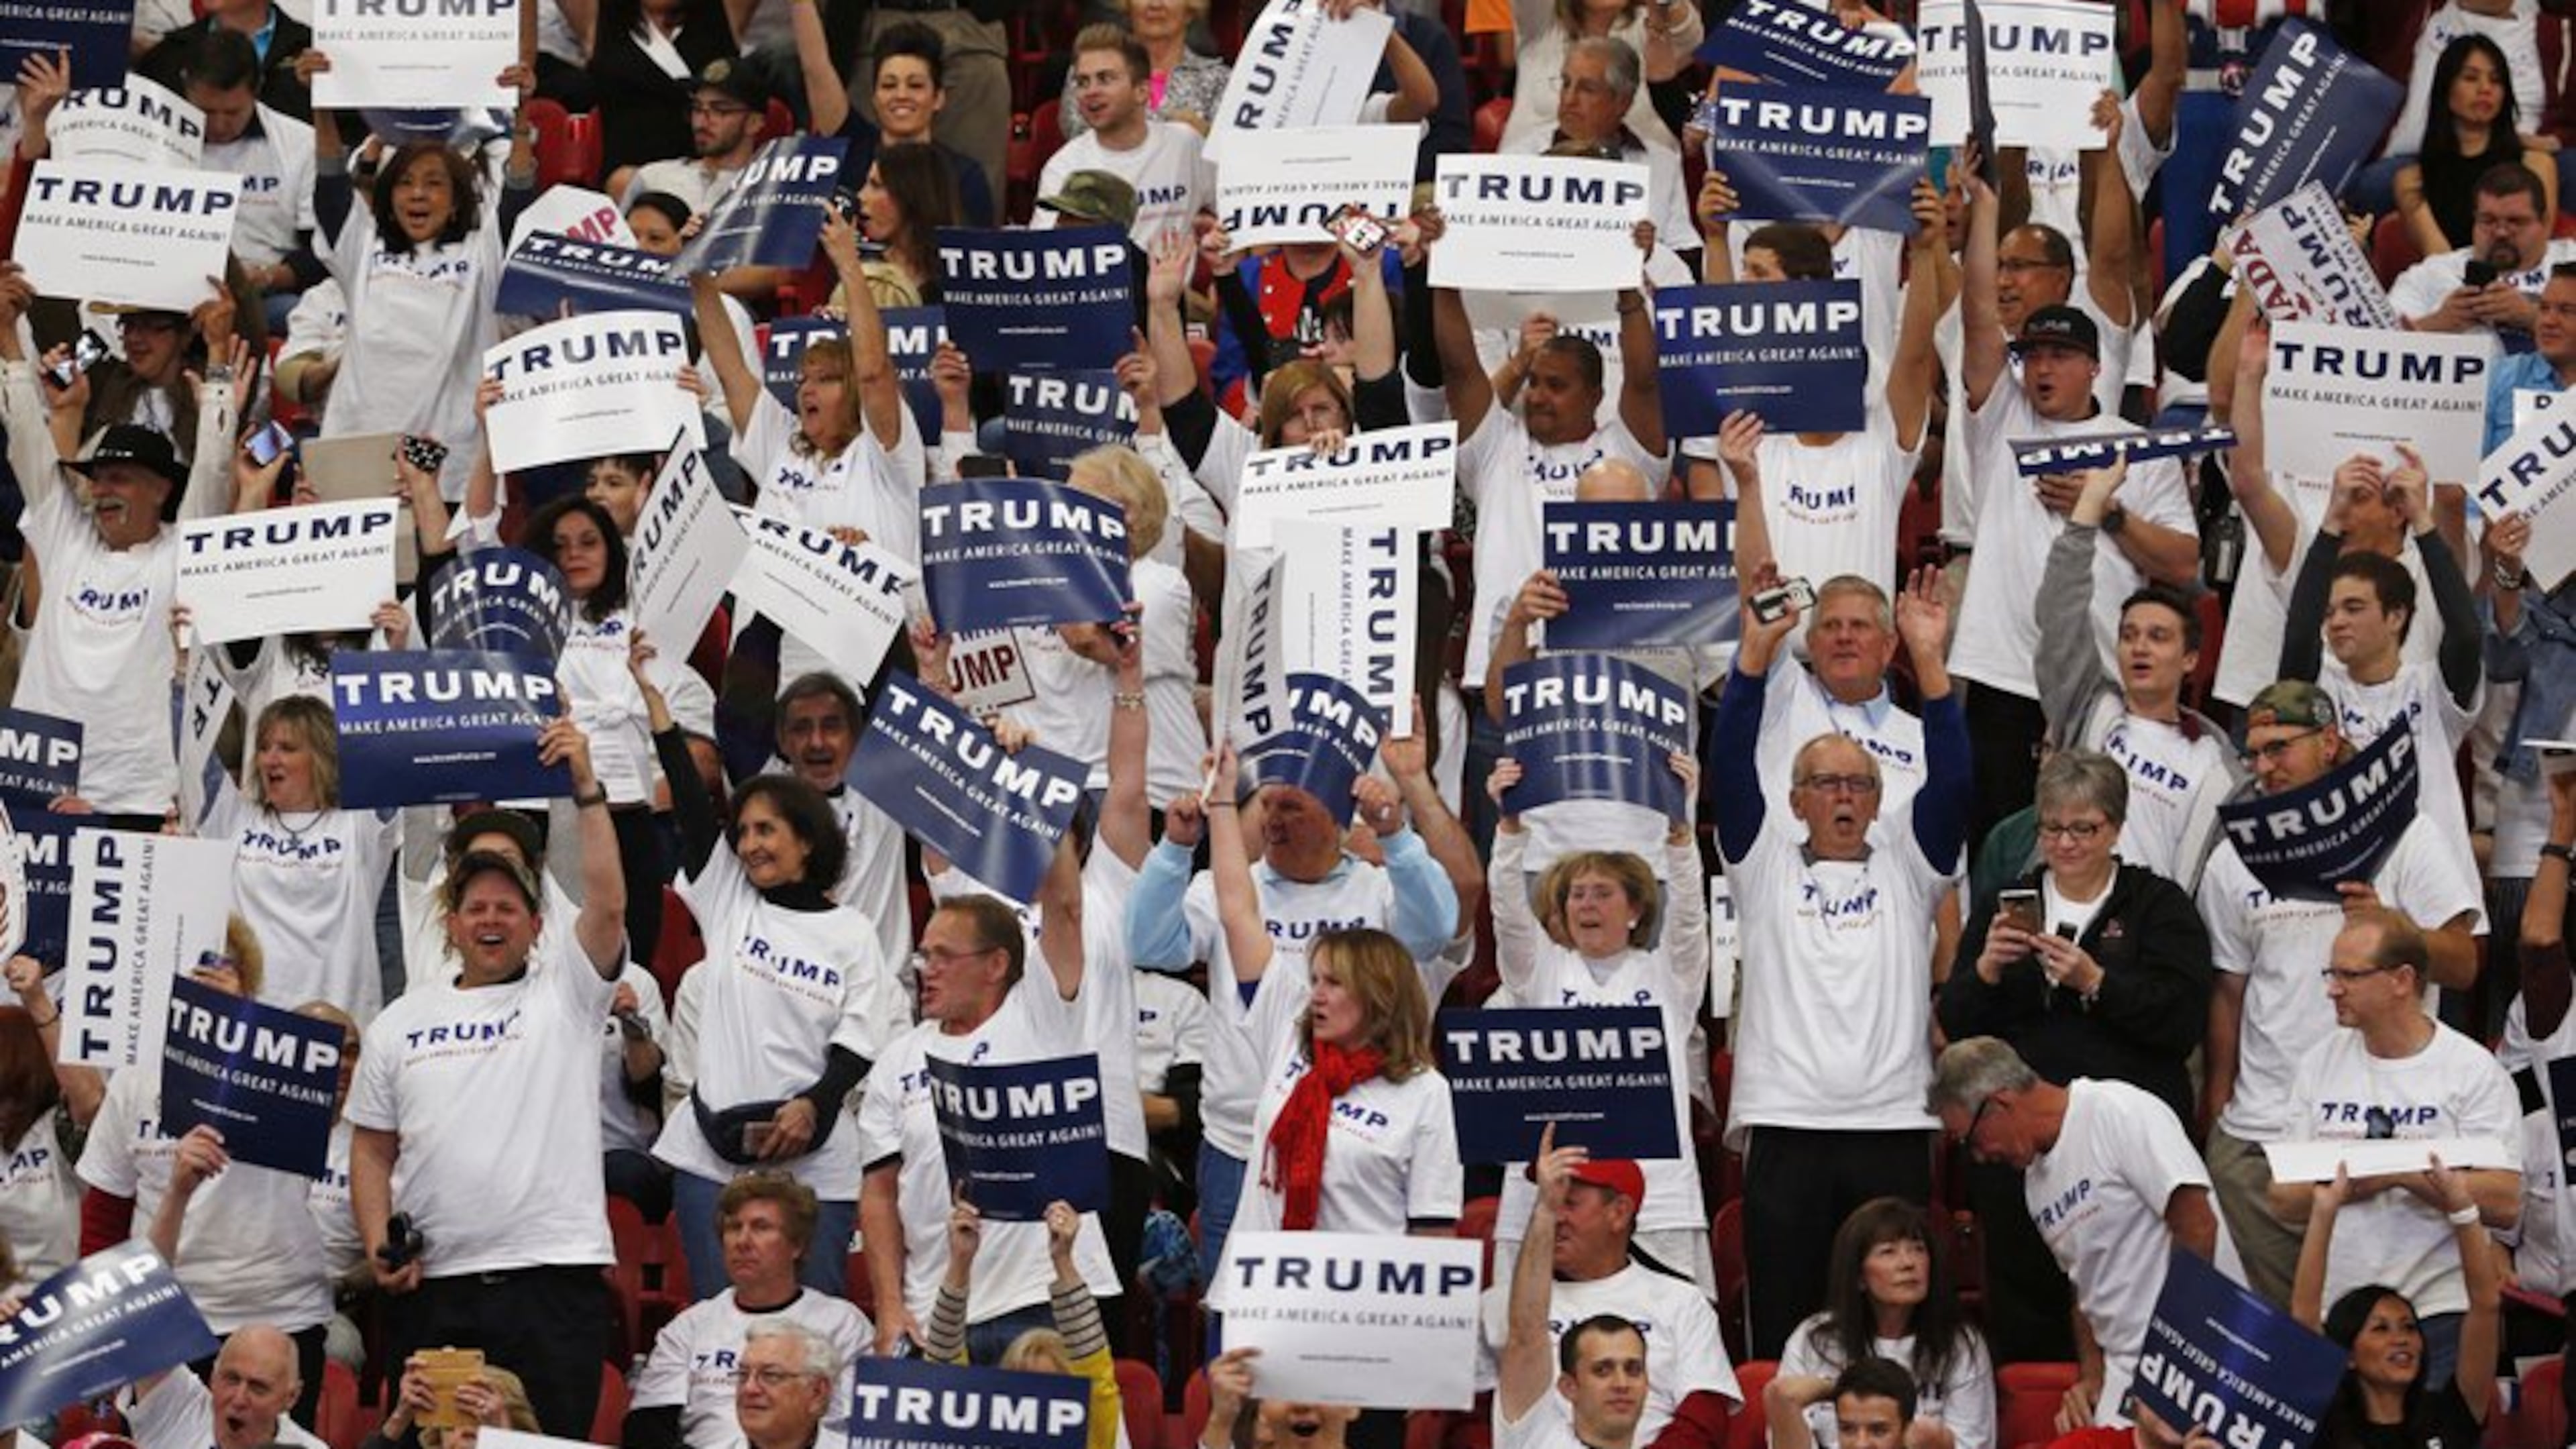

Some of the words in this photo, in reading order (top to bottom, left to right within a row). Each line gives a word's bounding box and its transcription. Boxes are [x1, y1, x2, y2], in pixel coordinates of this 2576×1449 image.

[0, 7, 41, 23] ERICA
[44, 8, 85, 21] GREAT
[325, 0, 516, 17] TRUMP
[317, 30, 352, 41] MAKE
[358, 30, 419, 41] AMERICA
[423, 30, 464, 41] GREAT
[1746, 0, 1916, 62] TRUMP
[1760, 28, 1815, 55] AMERICA
[1817, 50, 1853, 69] GREAT
[2013, 67, 2057, 80] GREAT
[1719, 97, 1928, 140] TRUMP
[2209, 32, 2320, 216] TRUMP
[1717, 138, 1755, 152] MAKE
[1759, 140, 1823, 158] AMERICA
[1828, 147, 1869, 162] GREAT
[1875, 152, 1925, 166] AGAIN!
[2254, 140, 2293, 197] AMERICA
[2291, 99, 2320, 142] GREAT
[36, 178, 234, 214] TRUMP
[1442, 174, 1643, 205] TRUMP
[26, 214, 66, 227] MAKE
[71, 216, 127, 233] AMERICA
[132, 222, 174, 237] GREAT
[180, 227, 227, 242] AGAIN!
[1479, 215, 1541, 229] AMERICA
[1546, 218, 1589, 231] GREAT
[941, 247, 1125, 281] TRUMP
[943, 289, 972, 303] MAKE
[975, 291, 1030, 305] AMERICA
[1034, 290, 1075, 305] GREAT
[1079, 287, 1129, 303] AGAIN!
[1657, 302, 1858, 337] TRUMP
[490, 330, 682, 380] TRUMP
[1660, 352, 1692, 368] MAKE
[1696, 349, 1756, 366] AMERICA
[1760, 347, 1804, 362] GREAT
[1809, 345, 1860, 360] AGAIN!
[2274, 341, 2483, 384] TRUMP
[598, 370, 641, 386] GREAT
[1008, 375, 1140, 415] TRUM
[2271, 387, 2310, 402] MAKE
[2314, 391, 2376, 408] AMERICA
[2381, 395, 2426, 411] GREAT
[2430, 398, 2481, 413] AGAIN!
[1042, 420, 1092, 439] AMERICA
[1247, 437, 1450, 476] TRUMP
[1243, 484, 1281, 496] MAKE
[1287, 478, 1350, 492] AMERICA
[1354, 474, 1398, 487] GREAT
[1403, 470, 1452, 484] AGAIN!
[184, 513, 392, 553] TRUMP
[922, 499, 1127, 539] TRUMP
[180, 562, 218, 576] MAKE
[223, 556, 287, 573] AMERICA
[291, 551, 335, 567] GREAT
[341, 544, 390, 560] AGAIN!
[755, 539, 811, 572] AMERICA
[815, 567, 856, 599] GREAT
[924, 549, 961, 564] MAKE
[965, 541, 1030, 561] AMERICA
[1034, 540, 1083, 556] GREAT
[433, 561, 564, 614] TRUM
[1593, 566, 1653, 580] AMERICA
[1660, 566, 1703, 580] GREAT
[1369, 527, 1396, 707] TRUM
[1243, 566, 1274, 734] TRUMP
[337, 669, 554, 706] TRUMP
[1505, 675, 1685, 725] TRUMP
[339, 720, 382, 735] MAKE
[386, 715, 455, 733] AMERICA
[460, 712, 504, 728] GREAT
[1543, 718, 1597, 737] AMERICA
[1602, 720, 1645, 739] GREAT
[887, 686, 1077, 807] TRUMP
[872, 716, 909, 745] MAKE
[910, 740, 967, 789] AMERICA
[965, 780, 1010, 817] GREAT
[1010, 811, 1063, 839] AGAIN!
[2228, 740, 2412, 845] TRUMP
[2285, 833, 2349, 863] AMERICA
[142, 841, 155, 896] AGAIN!
[138, 900, 150, 944] GREAT
[82, 837, 126, 1059] TRUMP
[129, 947, 146, 1019] AMERICA
[126, 1022, 137, 1066] MAKE
[168, 998, 340, 1073] TRUMP
[1448, 1028, 1663, 1062] TRUMP
[233, 1071, 276, 1094] GREAT
[280, 1081, 332, 1106] AGAIN!
[1452, 1077, 1494, 1091] MAKE
[1497, 1076, 1563, 1091] AMERICA
[1566, 1075, 1611, 1090] GREAT
[1615, 1073, 1668, 1088] AGAIN!
[1000, 1130, 1046, 1148] GREAT
[1049, 1124, 1103, 1144] AGAIN!
[1236, 1257, 1474, 1297] TRUMP
[1, 1326, 66, 1369] AMERICA
[71, 1307, 121, 1343] GREAT
[125, 1285, 180, 1316] AGAIN!
[1276, 1309, 1349, 1324] AMERICA
[1356, 1312, 1408, 1328] GREAT
[1414, 1316, 1472, 1330] AGAIN!
[857, 1385, 1085, 1434] TRUMP
